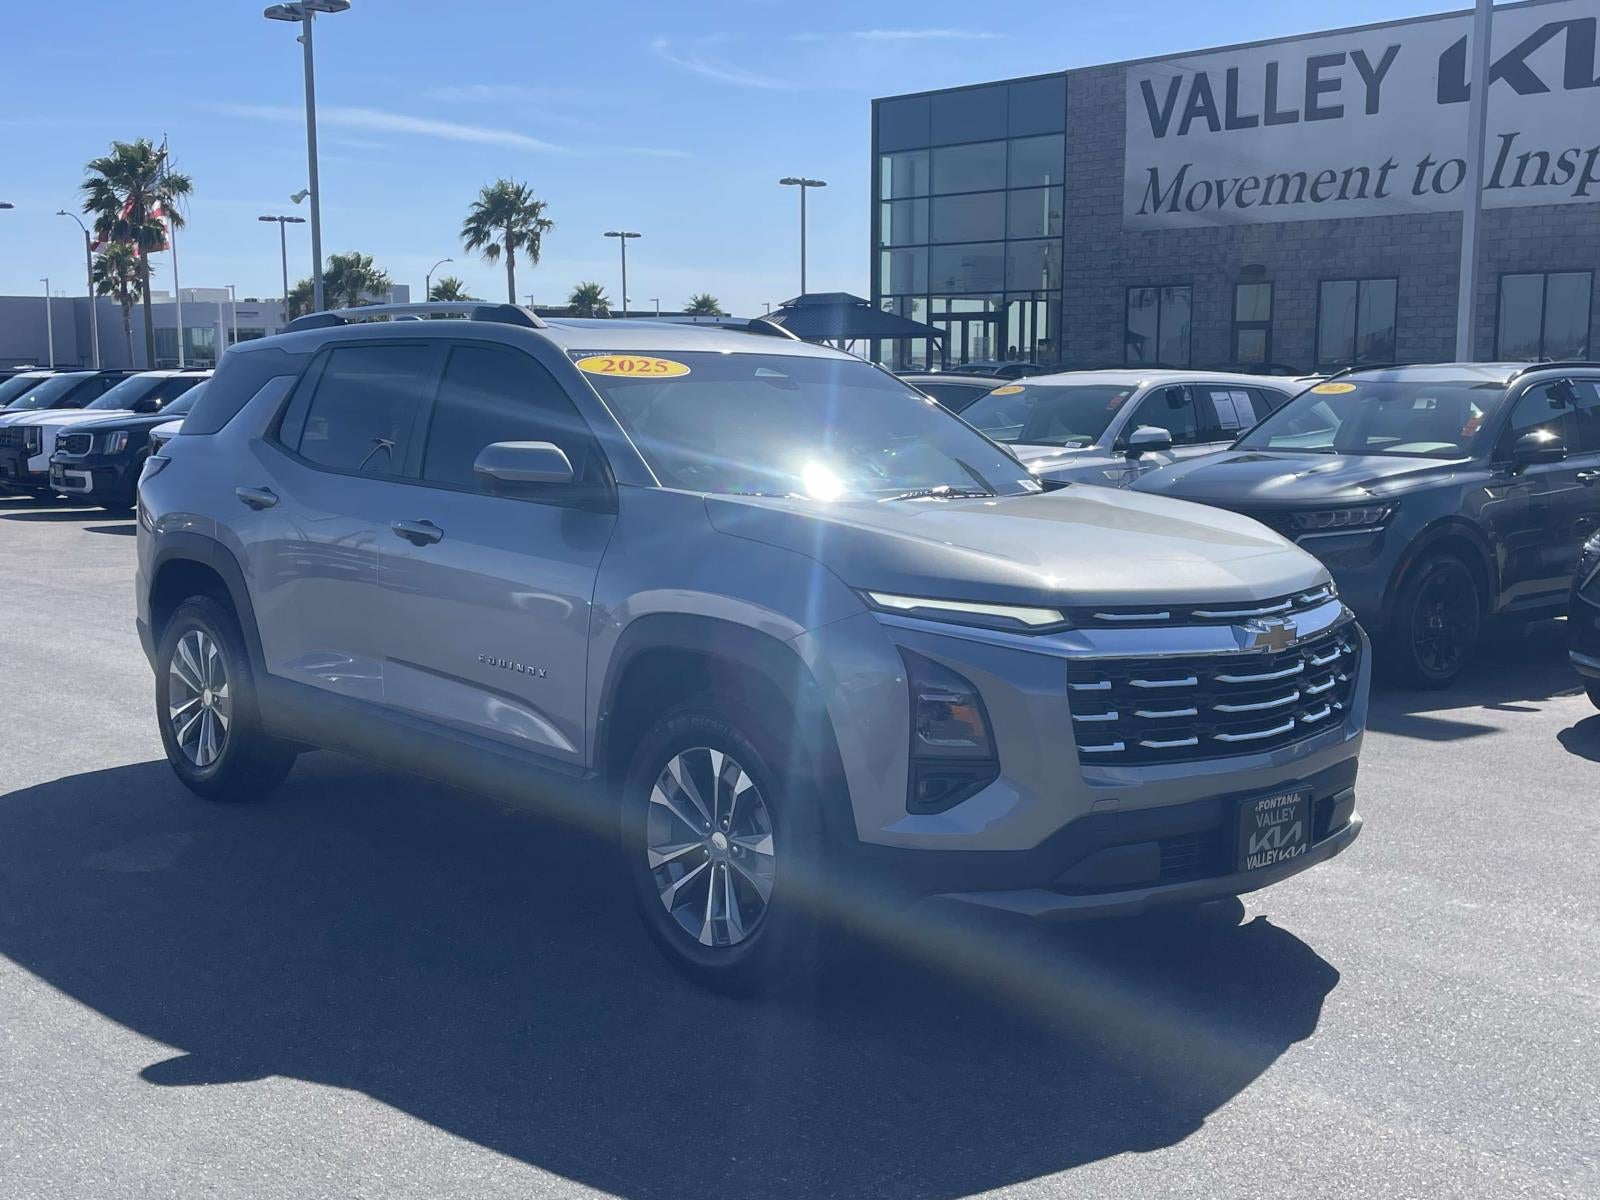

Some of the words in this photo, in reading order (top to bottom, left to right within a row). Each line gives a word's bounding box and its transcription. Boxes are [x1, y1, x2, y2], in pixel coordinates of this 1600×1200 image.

[1140, 43, 1402, 139] VALLEY
[1437, 17, 1600, 104] KI
[1135, 156, 1398, 216] Movement
[1411, 152, 1465, 196] to
[600, 359, 668, 373] 2025
[478, 653, 547, 678] EQUINOX
[1257, 793, 1300, 811] FONTANA
[1256, 806, 1296, 828] VALLEY
[1249, 821, 1302, 854] KIA
[1247, 849, 1278, 870] VALLEY
[1279, 843, 1306, 861] KIA
